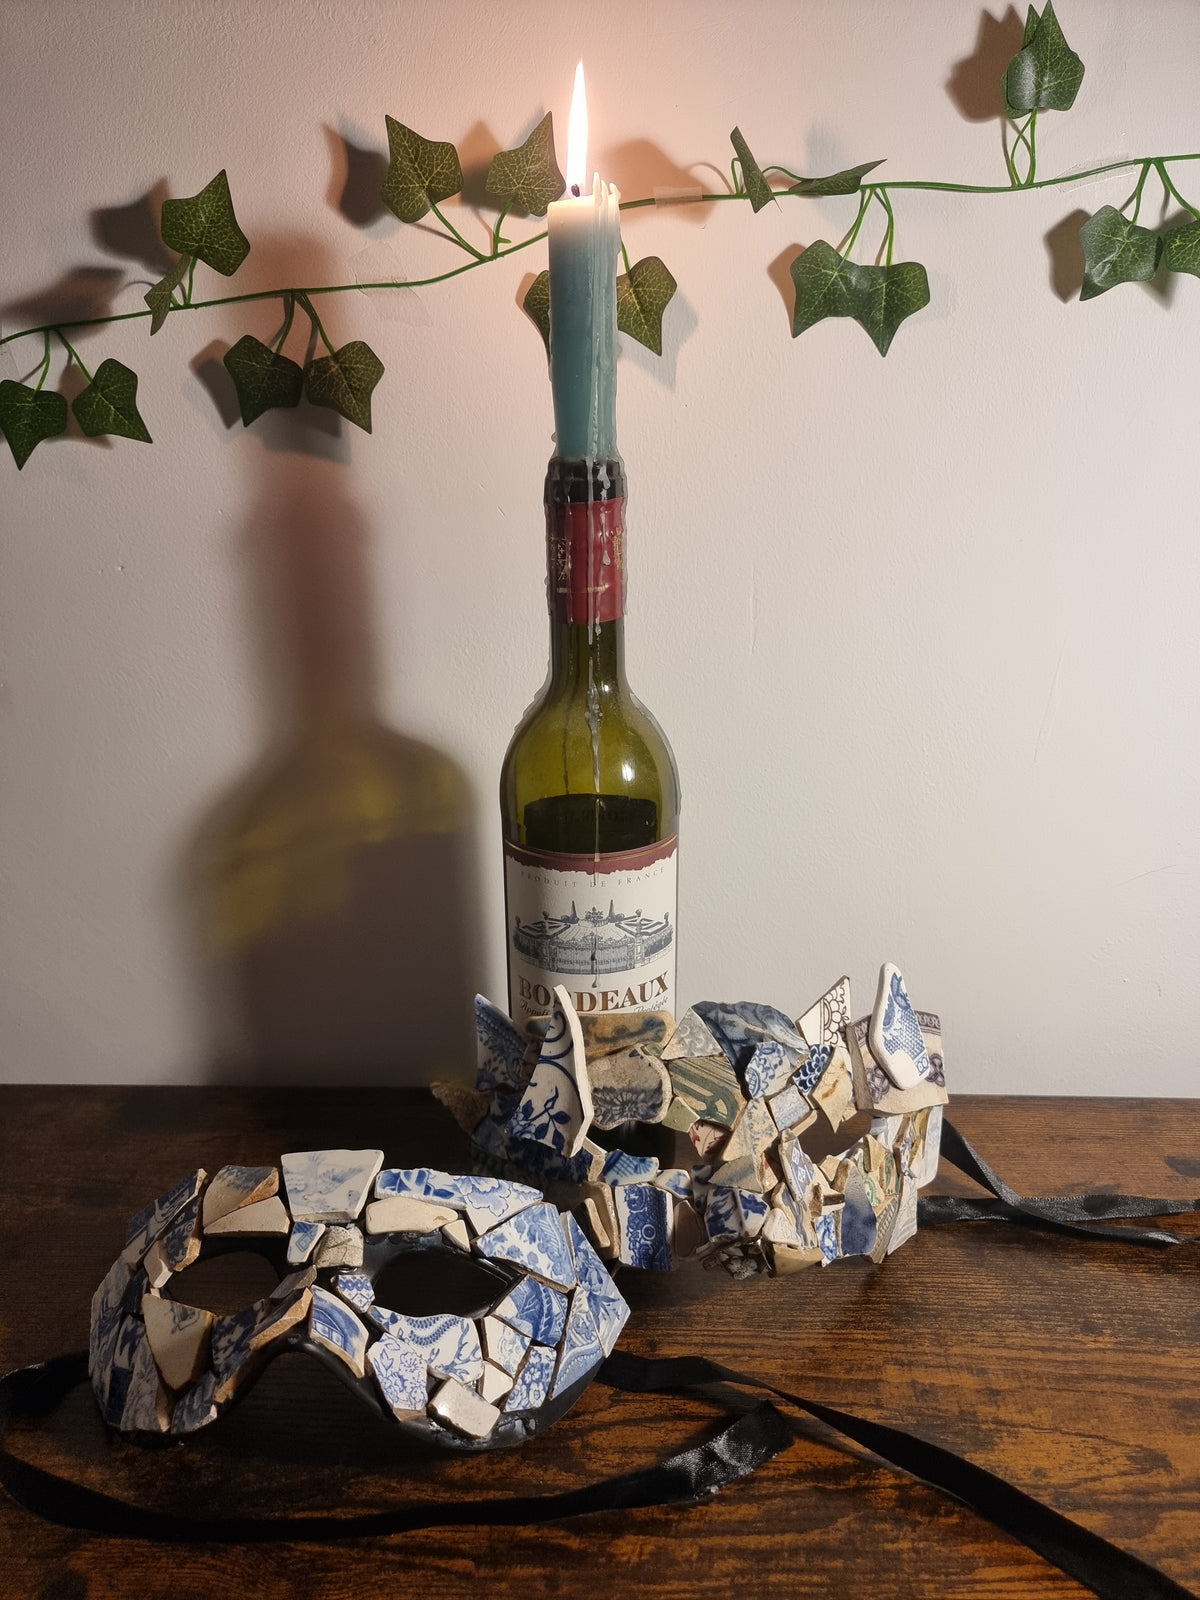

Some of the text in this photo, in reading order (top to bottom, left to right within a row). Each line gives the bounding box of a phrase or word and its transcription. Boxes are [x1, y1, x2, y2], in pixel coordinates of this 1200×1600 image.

[521, 867, 665, 888] PRODUIT DE FRANCE
[518, 970, 669, 1012] BODEAUX
